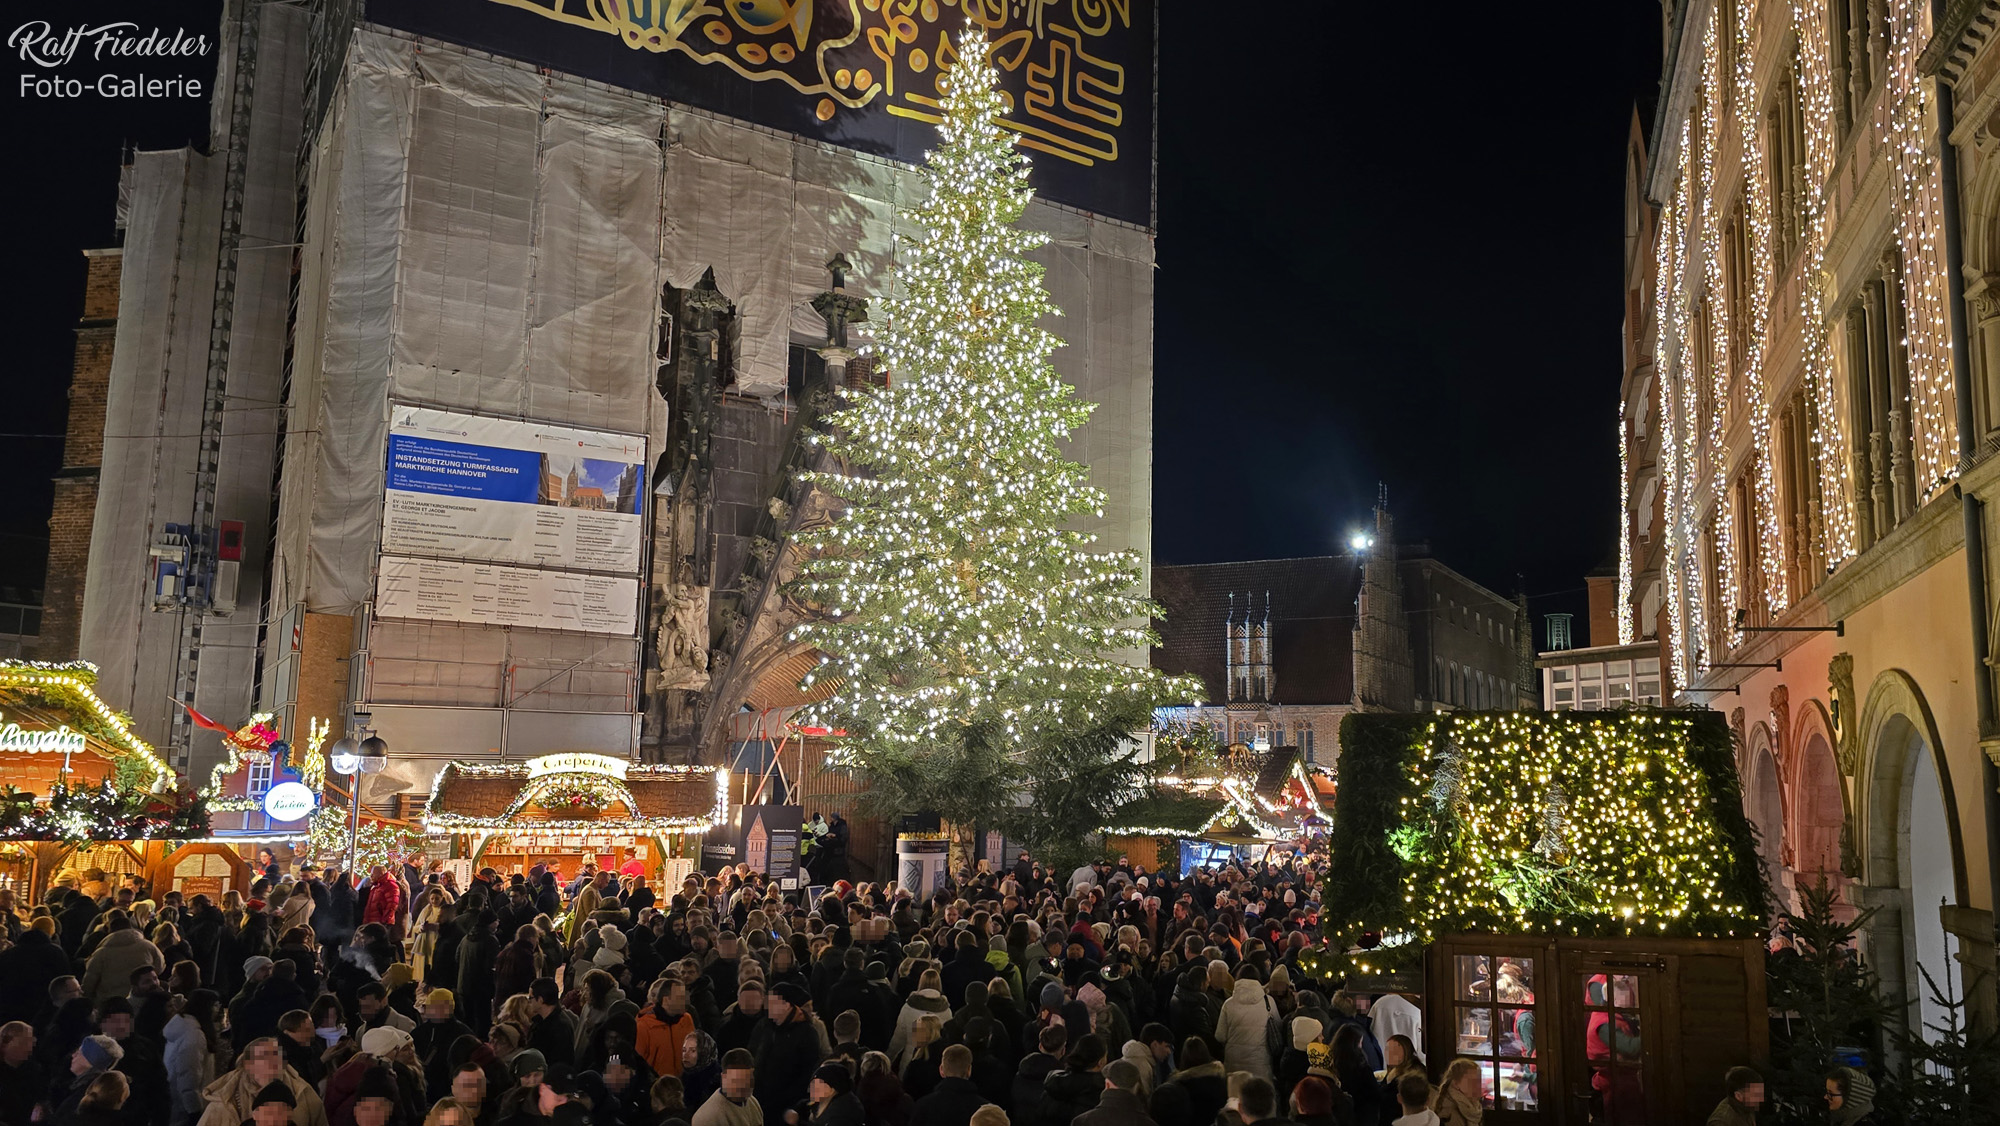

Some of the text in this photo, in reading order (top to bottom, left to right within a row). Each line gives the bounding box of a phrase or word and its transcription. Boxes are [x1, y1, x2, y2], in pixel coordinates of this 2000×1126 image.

[395, 454, 519, 474] INSTANDSETZUNG TURMFASSADEN
[395, 462, 487, 478] MARKTKIRCHE HANNOVER
